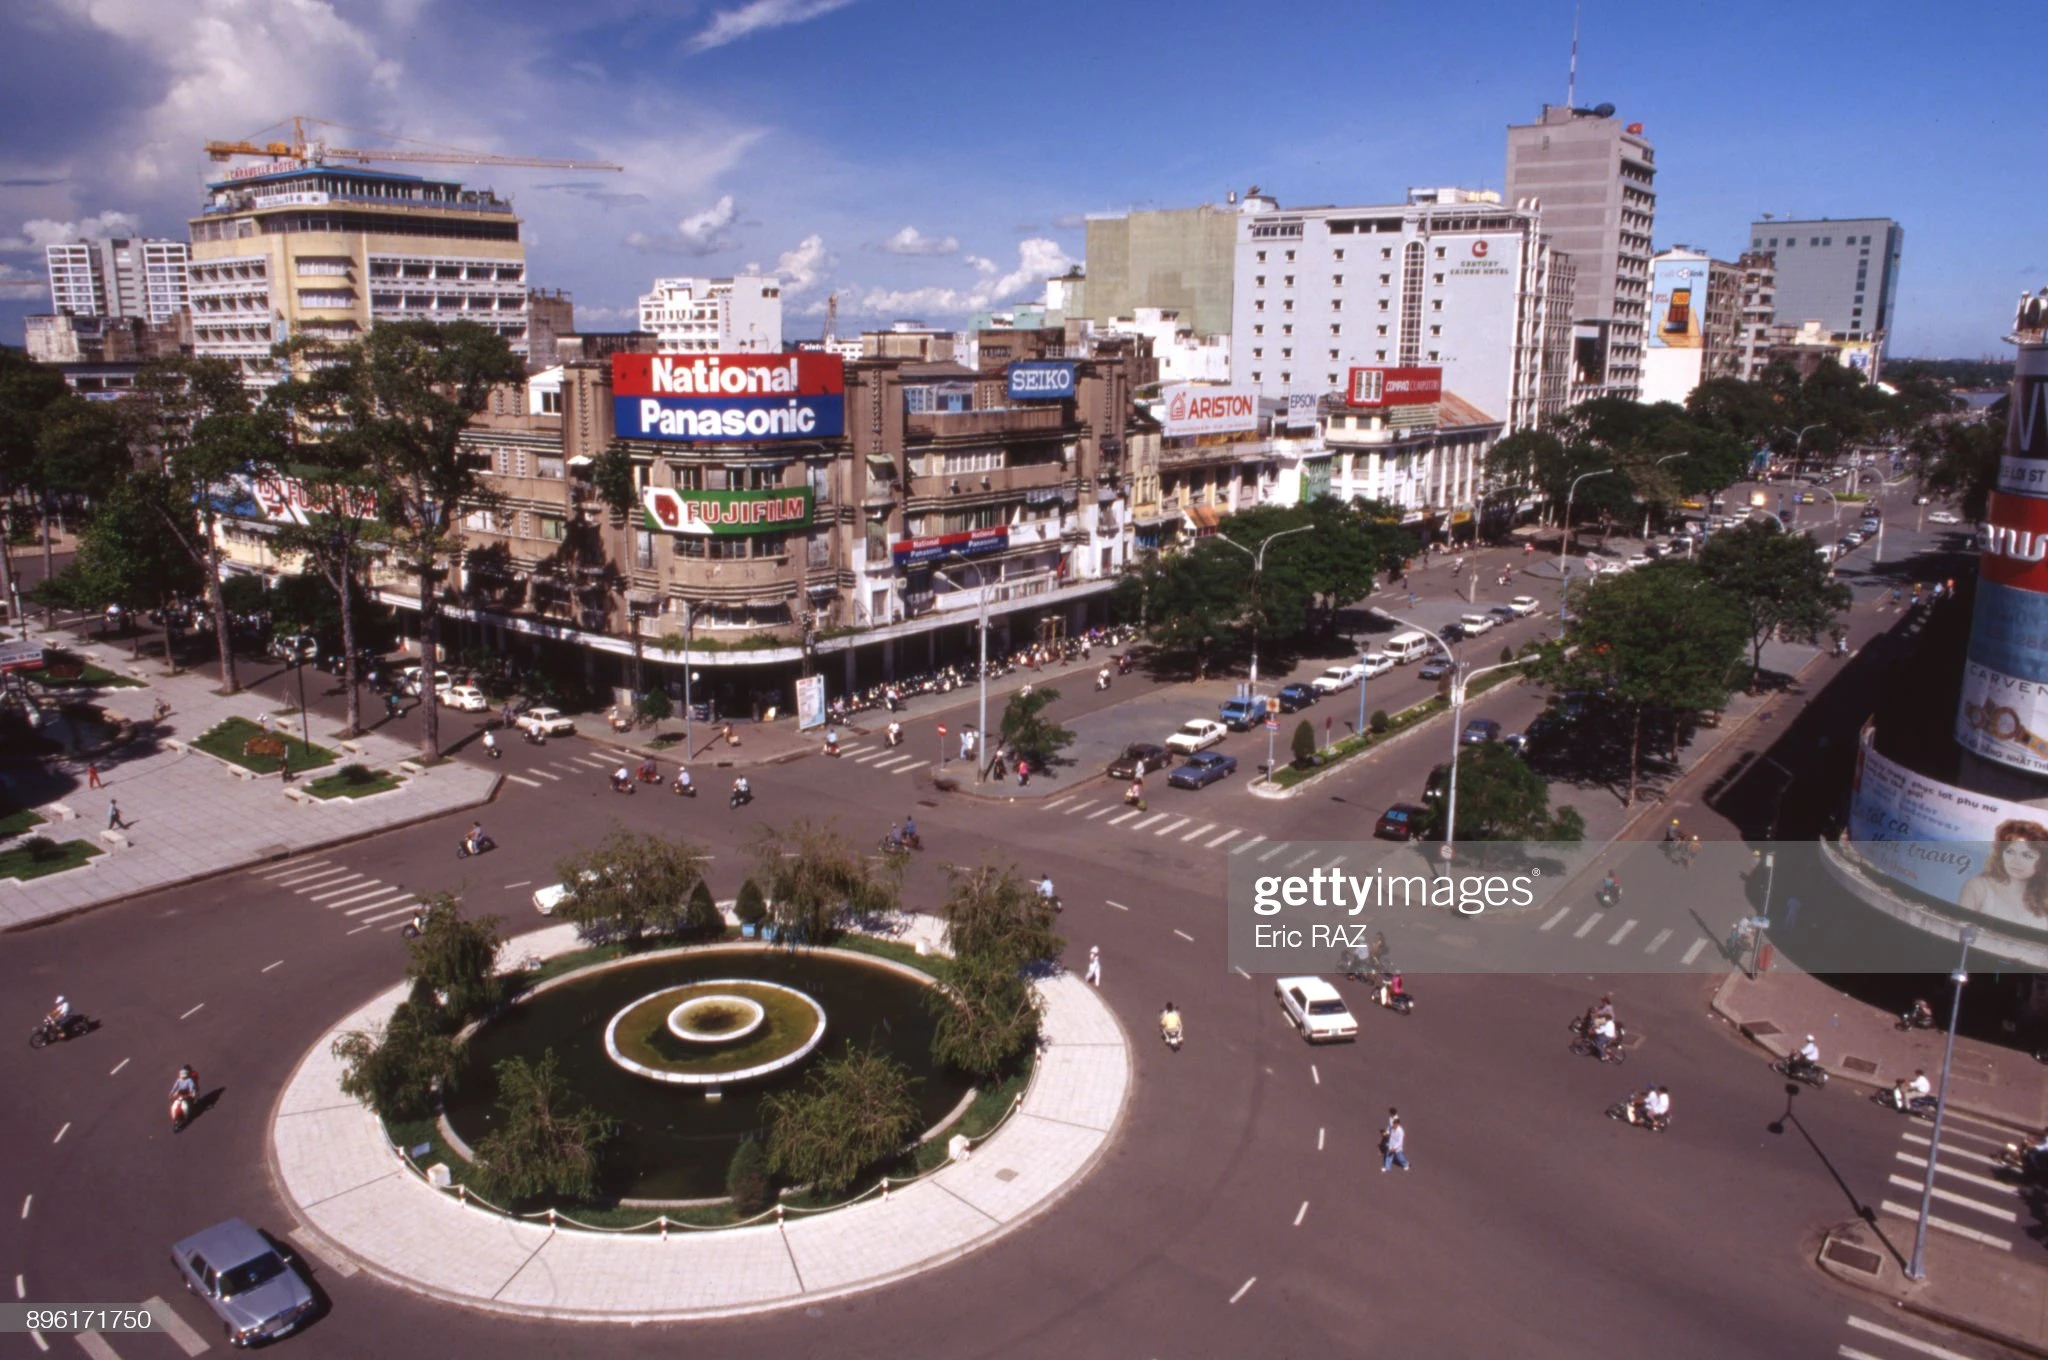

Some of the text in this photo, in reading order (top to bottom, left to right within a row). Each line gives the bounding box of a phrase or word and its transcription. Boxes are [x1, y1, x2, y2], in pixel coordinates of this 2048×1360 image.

[271, 159, 297, 174] HOTEL
[652, 357, 798, 392] National
[1012, 369, 1070, 391] SEIKO
[1188, 395, 1253, 420] ARISTON
[1290, 394, 1317, 409] EPSON
[641, 399, 816, 435] Panasonic
[687, 497, 804, 524] FUJIFILM
[913, 538, 940, 549] National
[971, 528, 996, 539] National
